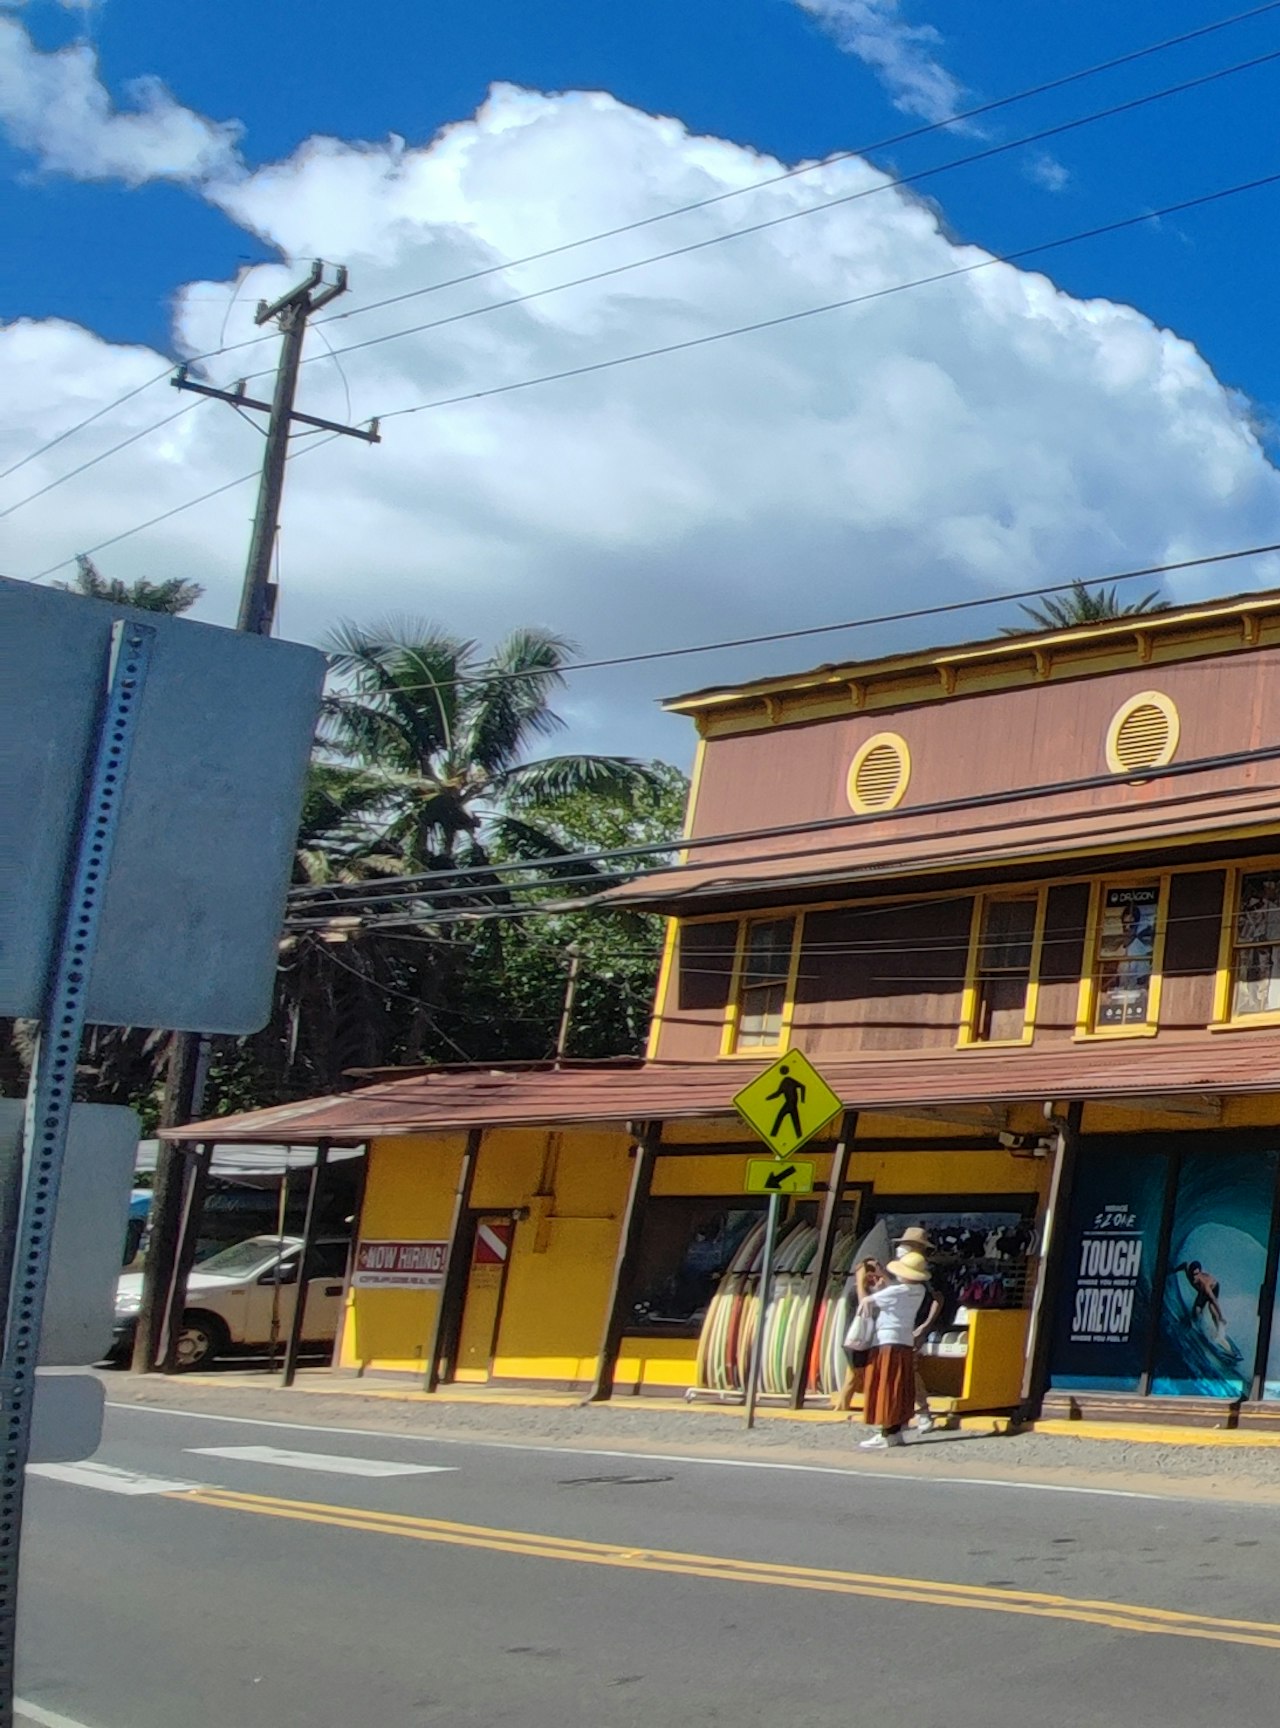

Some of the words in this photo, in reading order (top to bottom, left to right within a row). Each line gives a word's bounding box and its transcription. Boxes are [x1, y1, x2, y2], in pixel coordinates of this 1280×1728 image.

[1119, 890, 1155, 902] DRAGON
[366, 1247, 397, 1268] NOW
[398, 1247, 446, 1271] HIRING!
[1080, 1240, 1142, 1277] TOUGH
[1072, 1288, 1134, 1333] STRETCH
